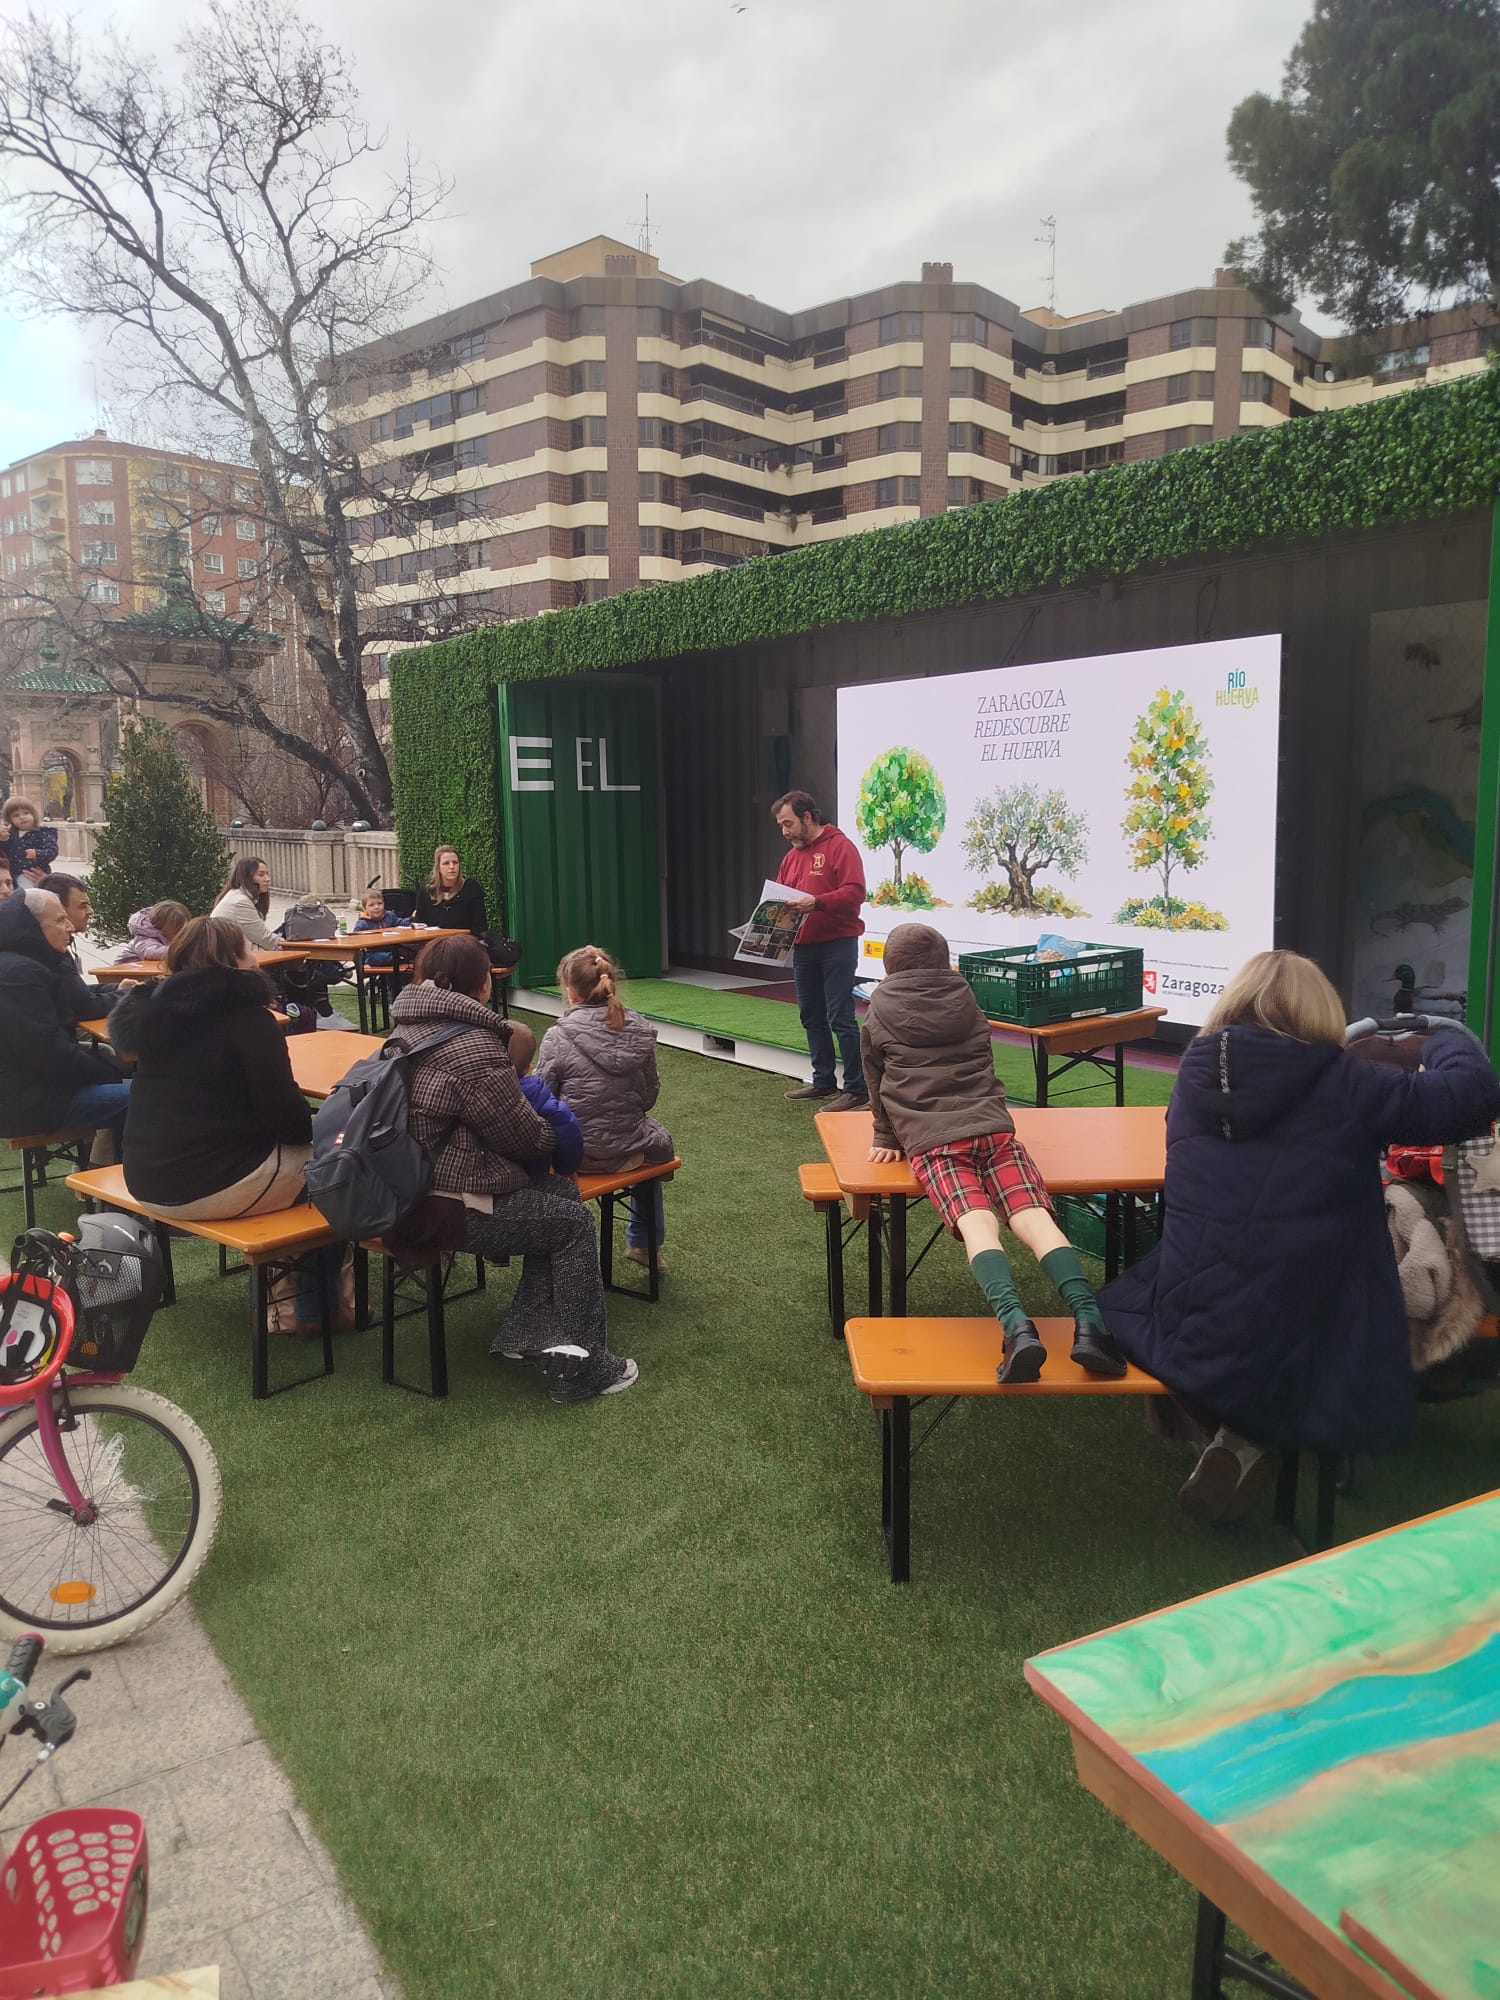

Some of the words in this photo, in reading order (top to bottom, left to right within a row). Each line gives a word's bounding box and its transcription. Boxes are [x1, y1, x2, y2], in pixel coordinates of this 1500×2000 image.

[1227, 667, 1246, 694] RÍO
[977, 688, 1067, 714] ZARAGOZA
[1215, 687, 1259, 709] HUERVA
[974, 713, 1071, 738] REDESCUBRE
[980, 743, 998, 761] EL
[1001, 739, 1061, 760] HUERVA
[1161, 974, 1225, 998] Zaragoza
